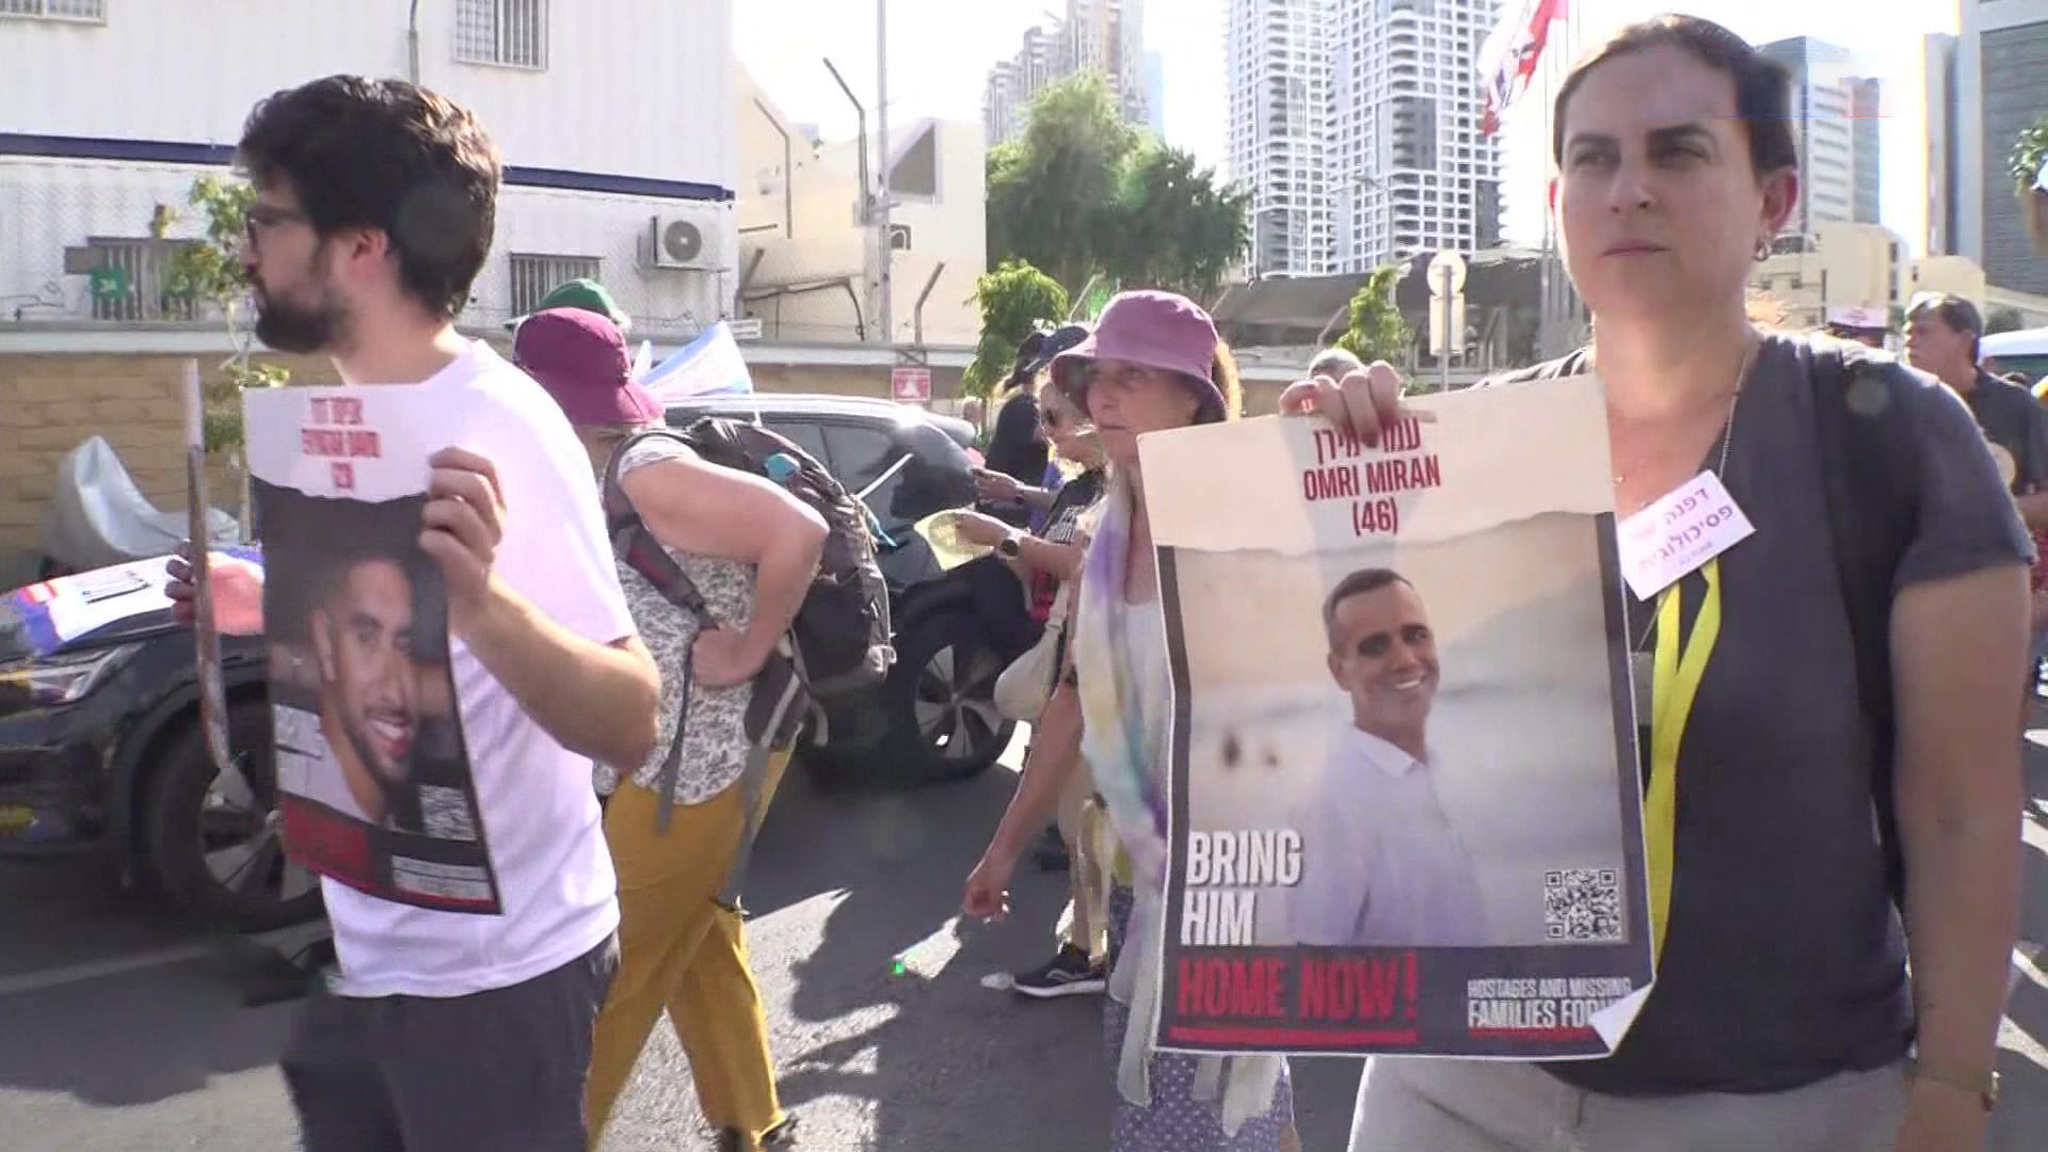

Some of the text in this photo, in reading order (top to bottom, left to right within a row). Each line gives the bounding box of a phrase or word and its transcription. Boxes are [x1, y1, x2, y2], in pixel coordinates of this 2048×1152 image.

[1303, 454, 1441, 501] OMRI MIRAN
[1352, 496, 1398, 537] (46)
[1664, 487, 1709, 525] דפנה
[1185, 829, 1302, 886] BRING
[1180, 889, 1255, 946] HIM
[1177, 949, 1417, 1021] HOME NOW!
[1468, 976, 1632, 999] HOSTAGES AND MISSING
[1468, 999, 1616, 1028] FAMILIES FOR
